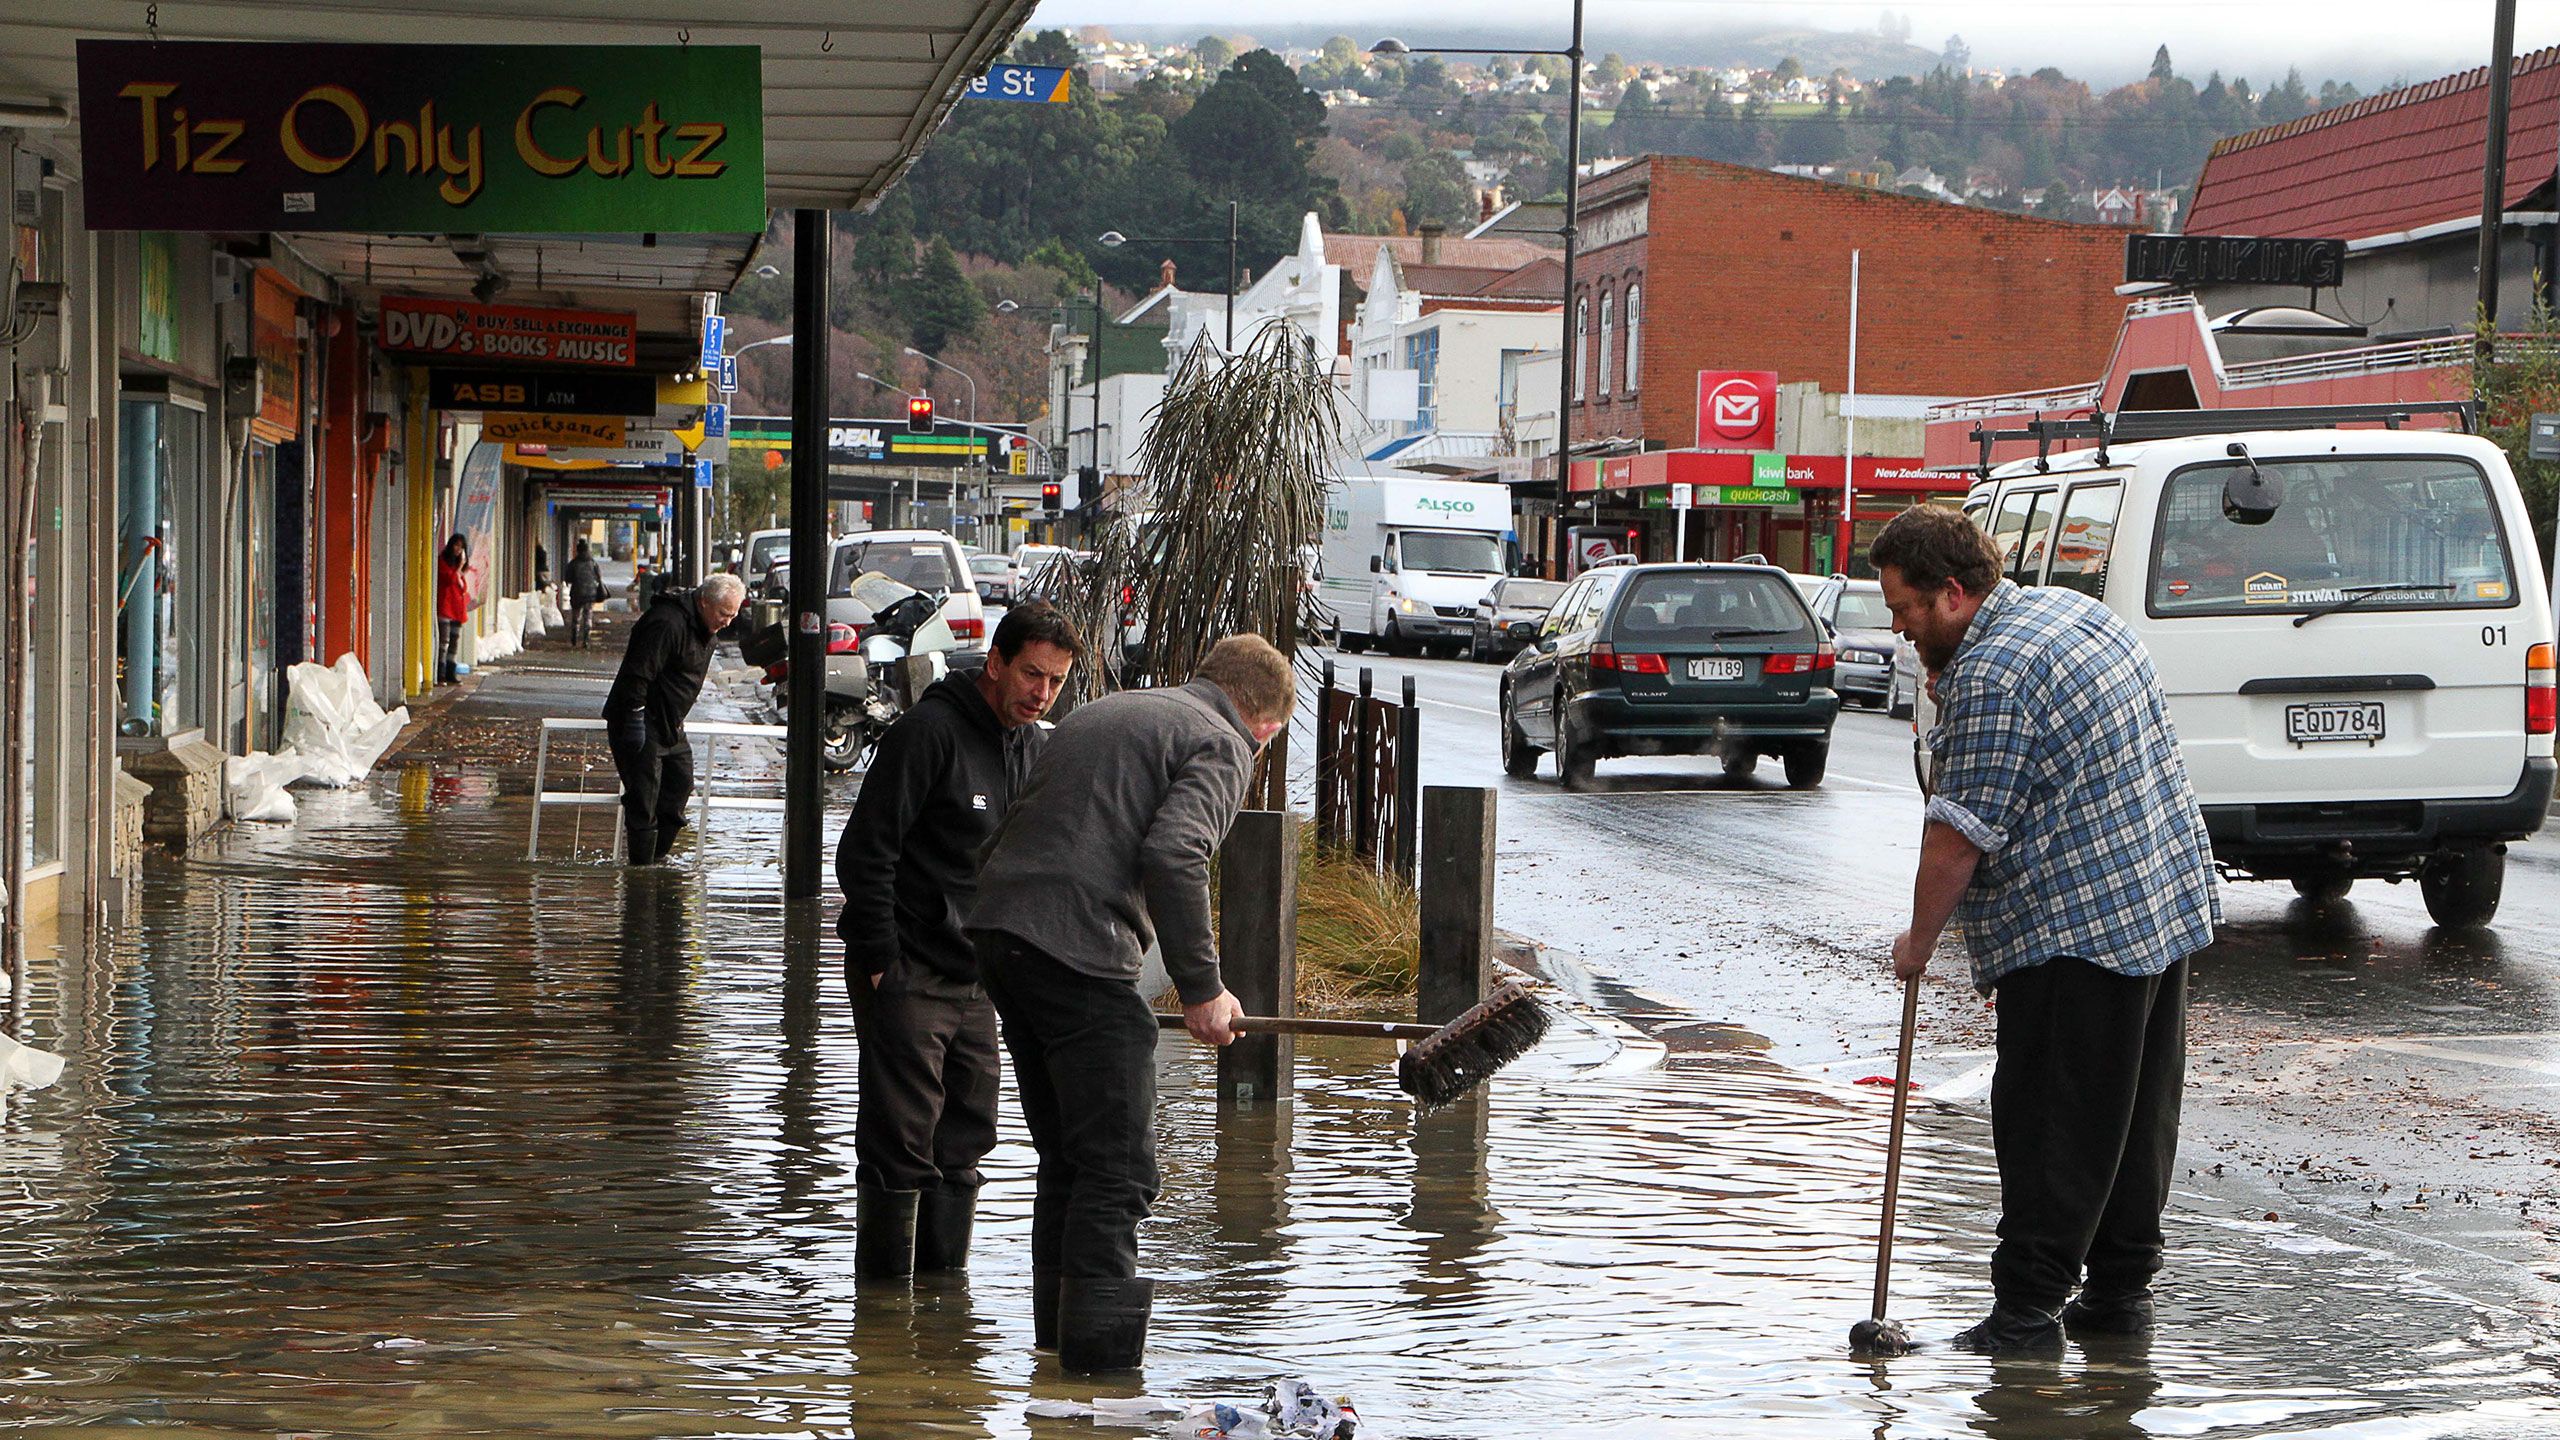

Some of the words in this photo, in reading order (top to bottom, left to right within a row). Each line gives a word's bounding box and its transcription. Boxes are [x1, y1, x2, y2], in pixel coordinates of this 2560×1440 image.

[1002, 69, 1036, 96] St
[118, 81, 248, 174] Tiz
[279, 83, 484, 206] Only
[513, 85, 728, 178] Cutz
[2136, 240, 2337, 284] NANKING
[384, 309, 475, 352] DVD's
[483, 333, 549, 358] BOOKS
[555, 339, 629, 363] MUSIC
[512, 316, 544, 333] SELL
[557, 320, 630, 339] EXCHANGE
[710, 318, 719, 335] P
[724, 358, 732, 373] P
[453, 383, 526, 404] ASB
[546, 392, 577, 406] ATM
[489, 415, 618, 442] Quicksands
[635, 440, 664, 450] MART
[1874, 467, 1900, 480] New
[1416, 497, 1476, 513] ALSCO
[2249, 582, 2283, 591] STEWART
[2418, 590, 2436, 600] Ltd
[2481, 625, 2507, 647] 01
[2292, 709, 2381, 735] EQD784
